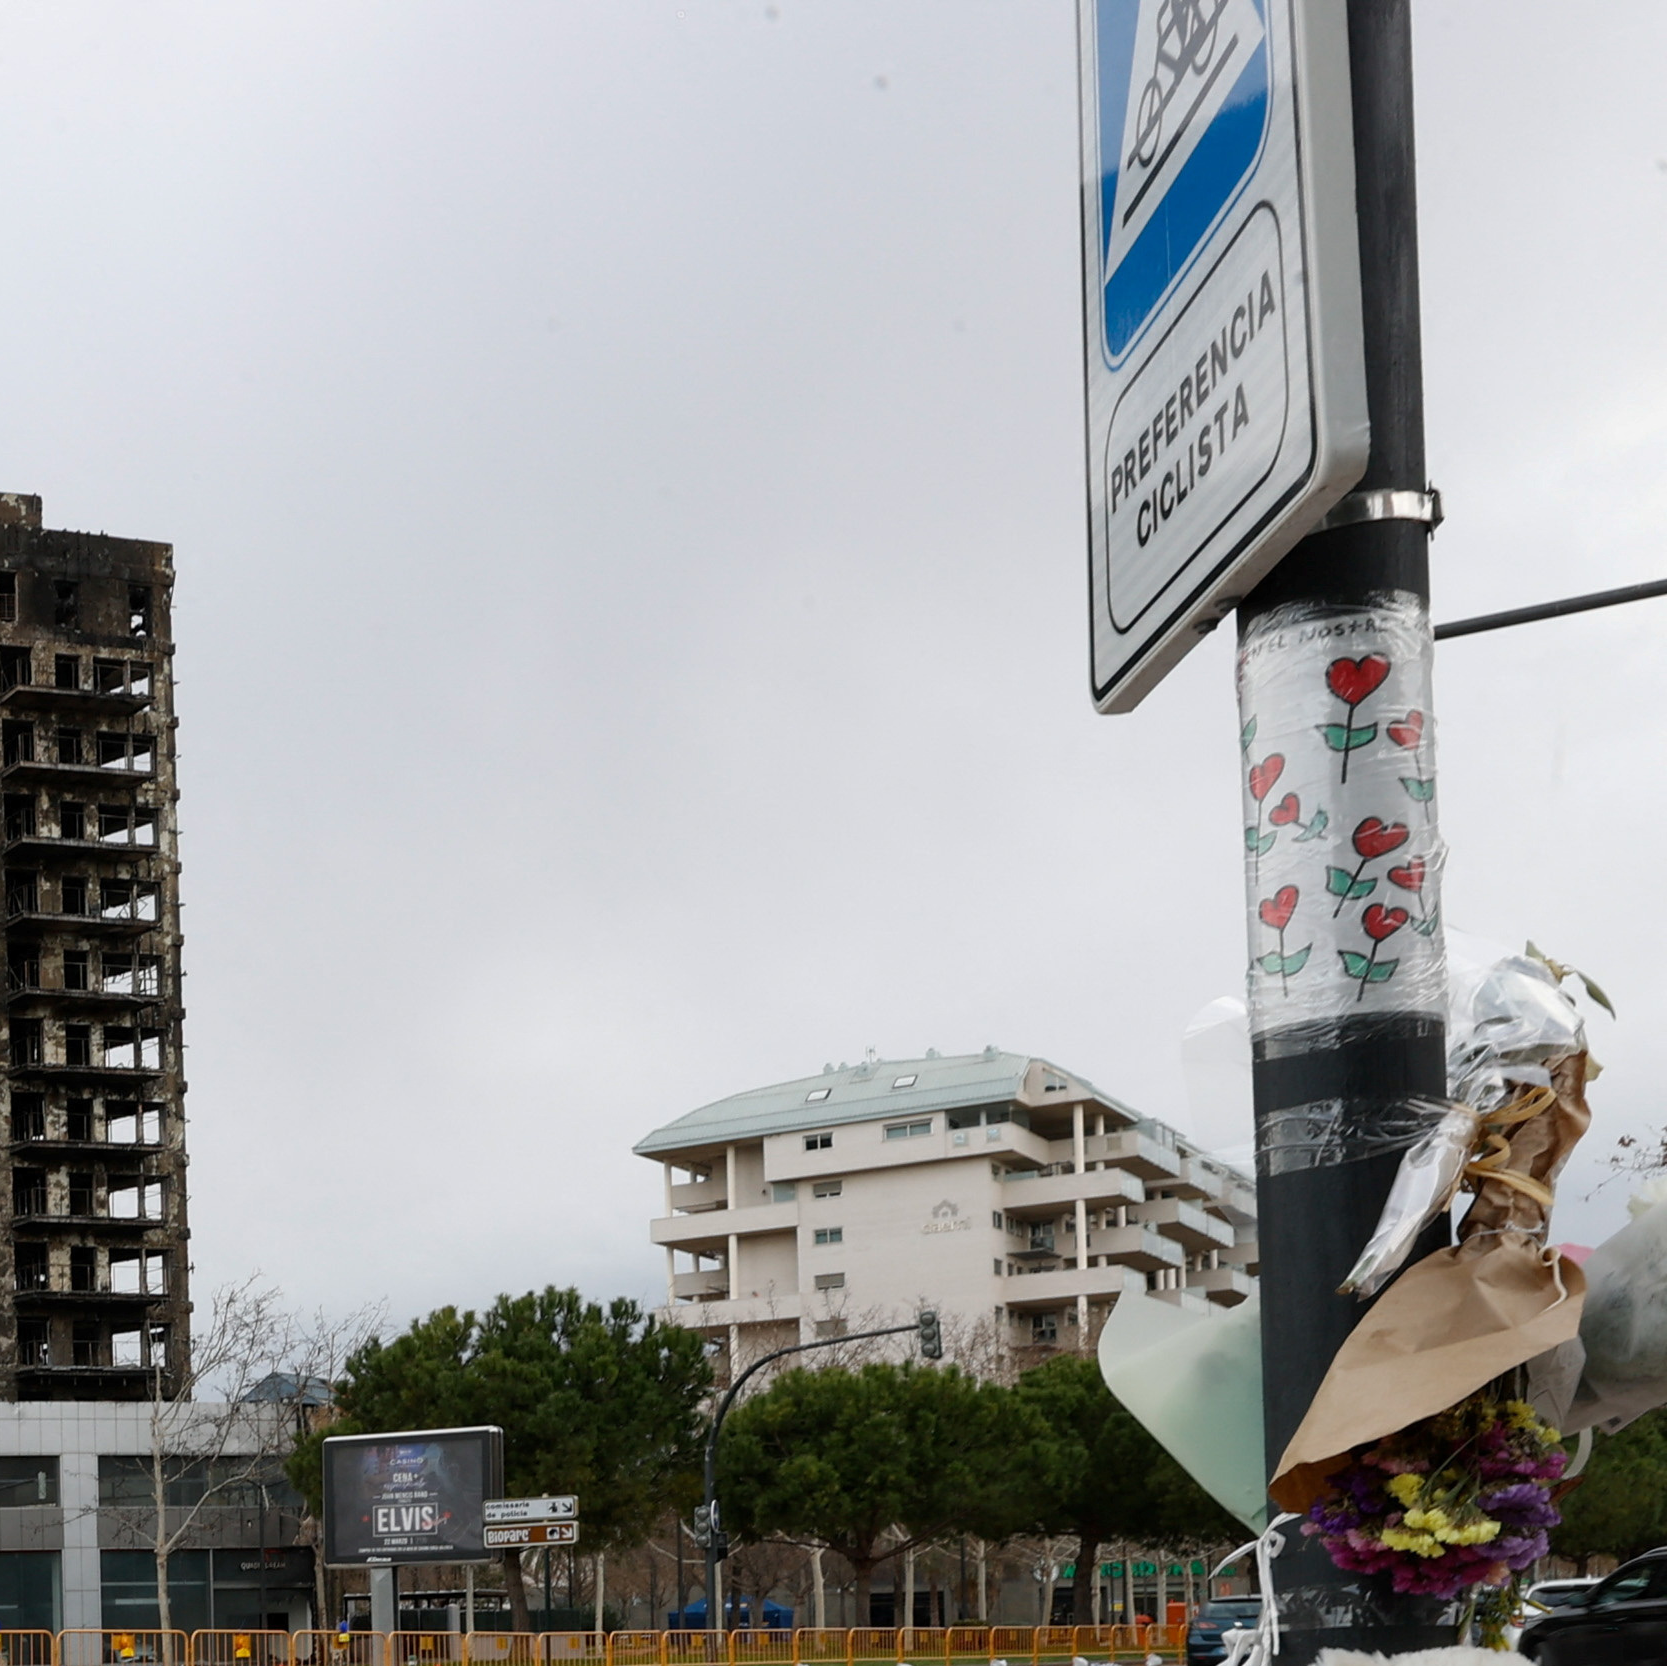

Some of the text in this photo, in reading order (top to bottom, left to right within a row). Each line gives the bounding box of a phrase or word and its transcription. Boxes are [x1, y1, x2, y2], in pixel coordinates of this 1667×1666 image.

[1111, 268, 1276, 514] PREFERENCIA
[1136, 381, 1250, 548] CICLISTA
[389, 1457, 424, 1466] CASINO
[377, 1506, 434, 1532] ELVIS
[486, 1511, 496, 1519] de
